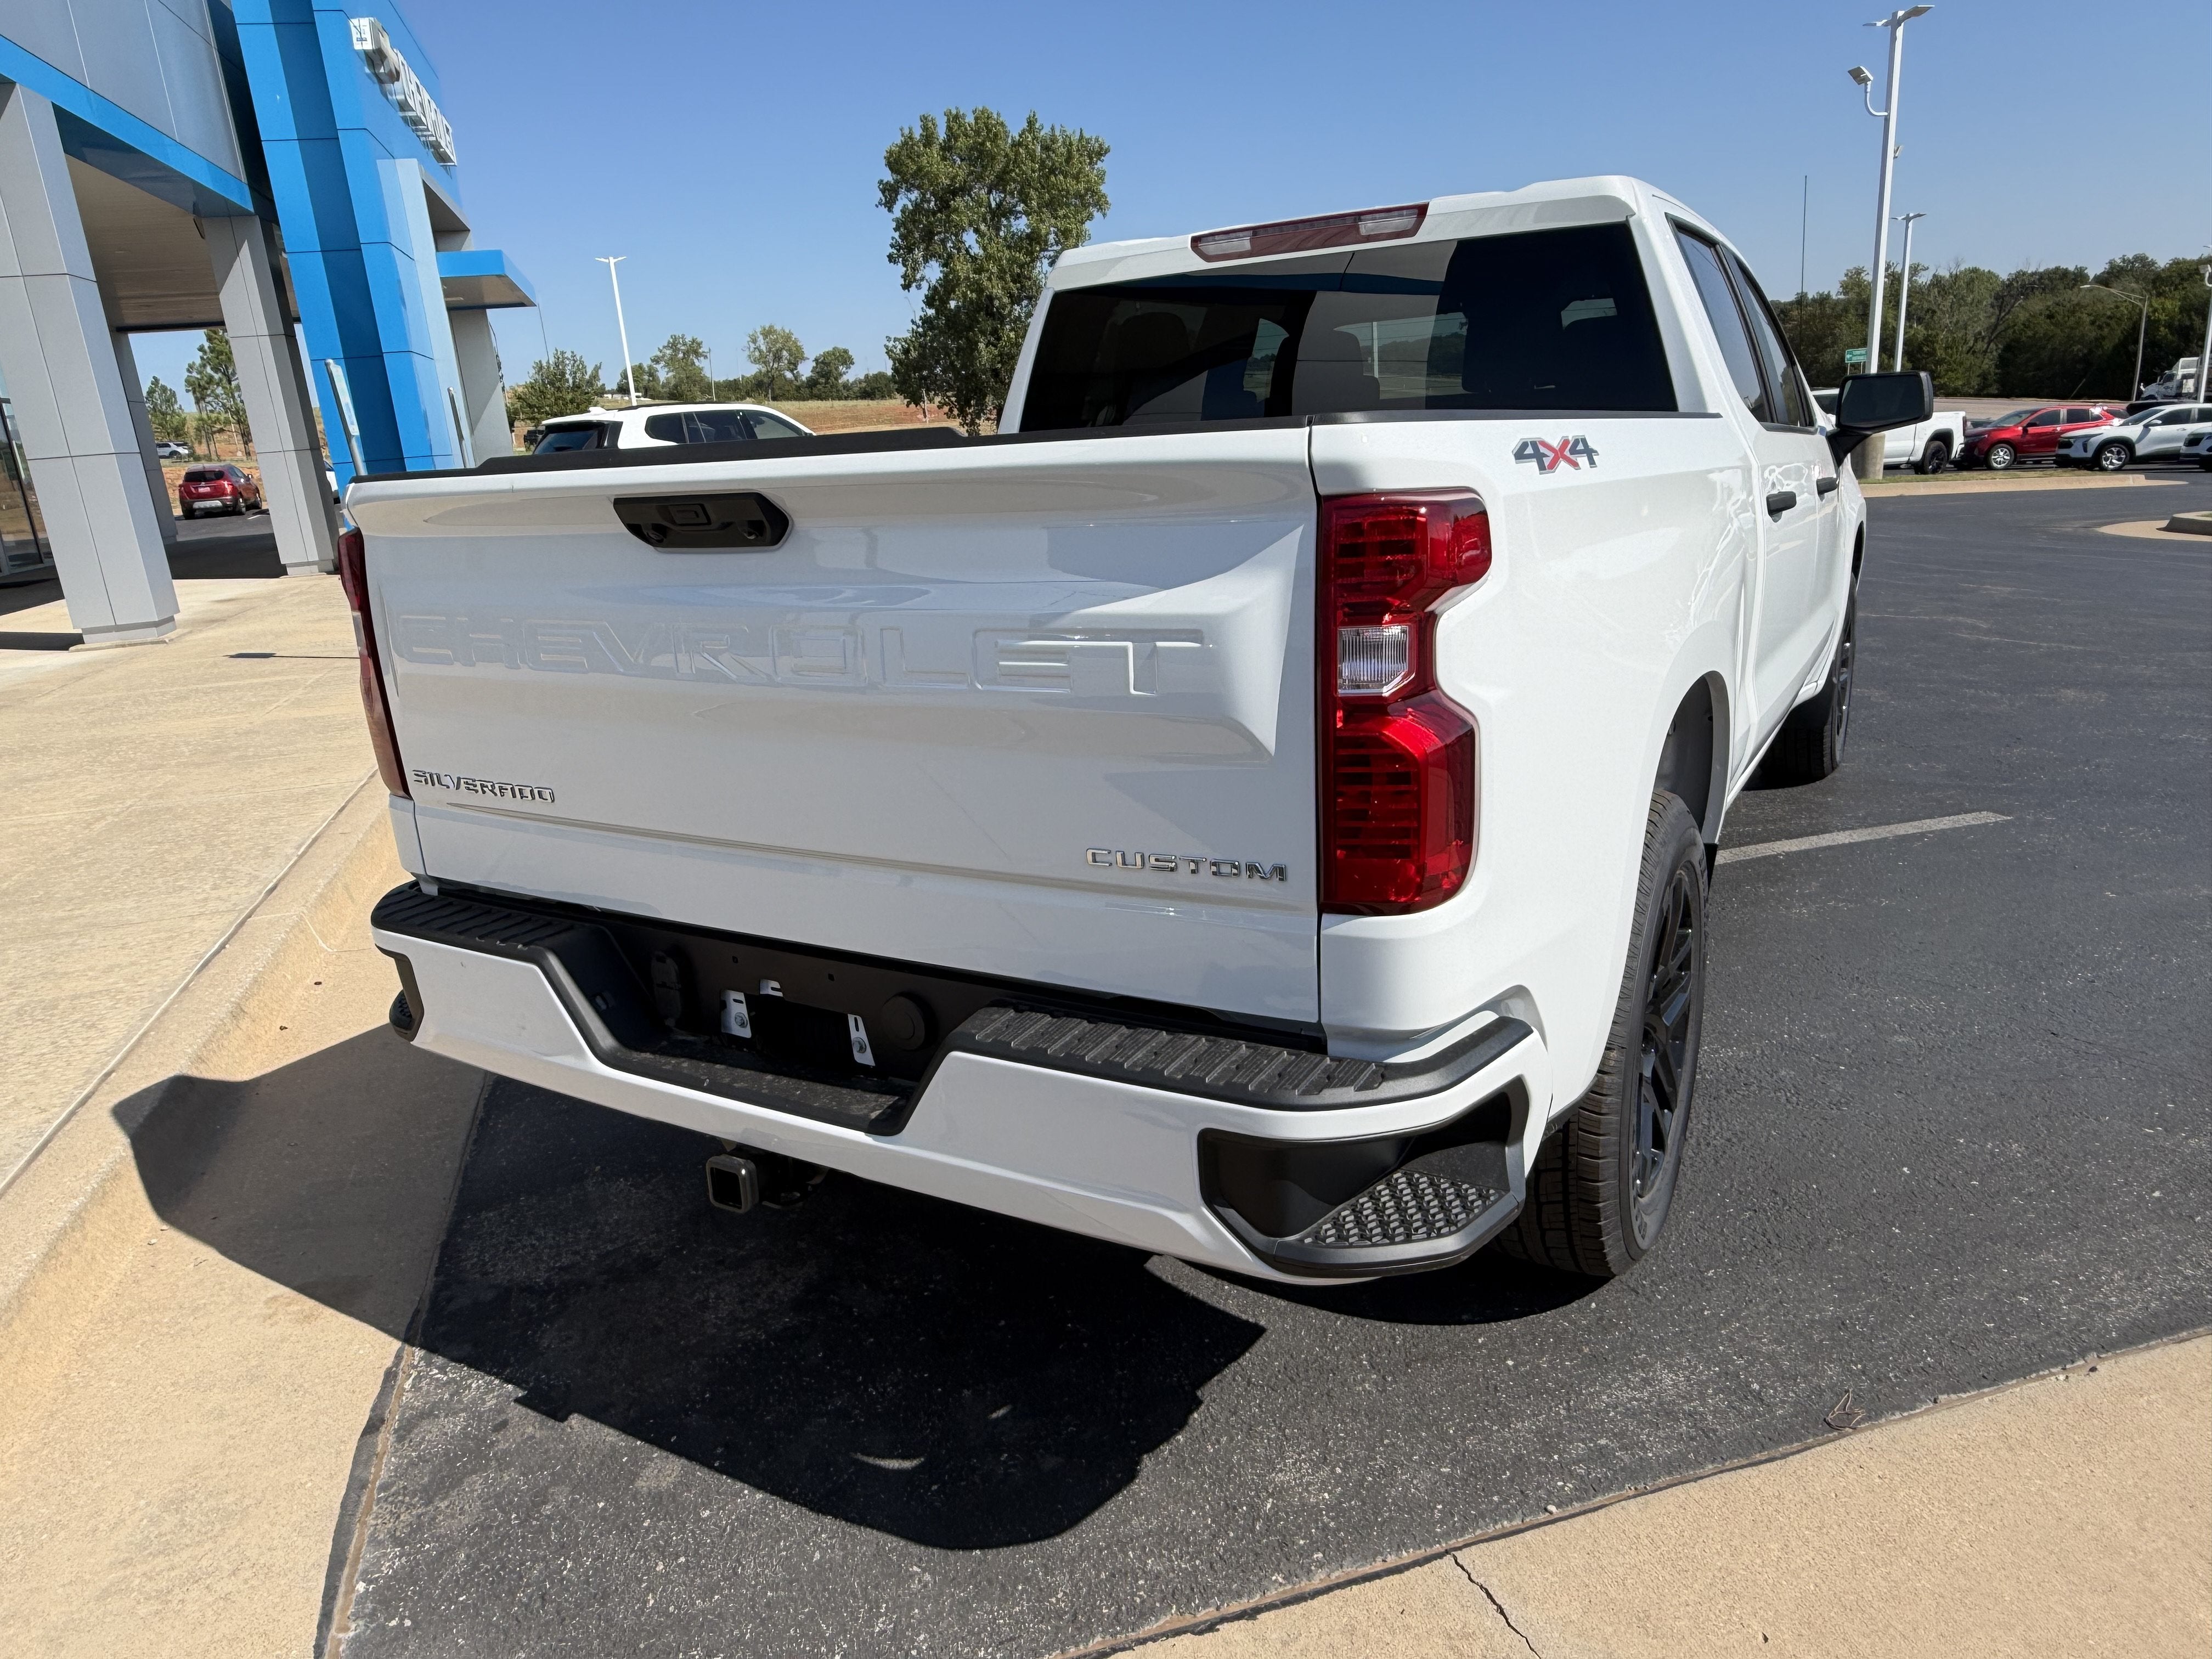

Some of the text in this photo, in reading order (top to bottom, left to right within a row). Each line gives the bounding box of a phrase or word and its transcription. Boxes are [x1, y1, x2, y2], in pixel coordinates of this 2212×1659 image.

[394, 614, 1204, 696] CHEVROLET
[413, 770, 555, 803] SILVERADO
[1086, 848, 1287, 882] CUSTOM
